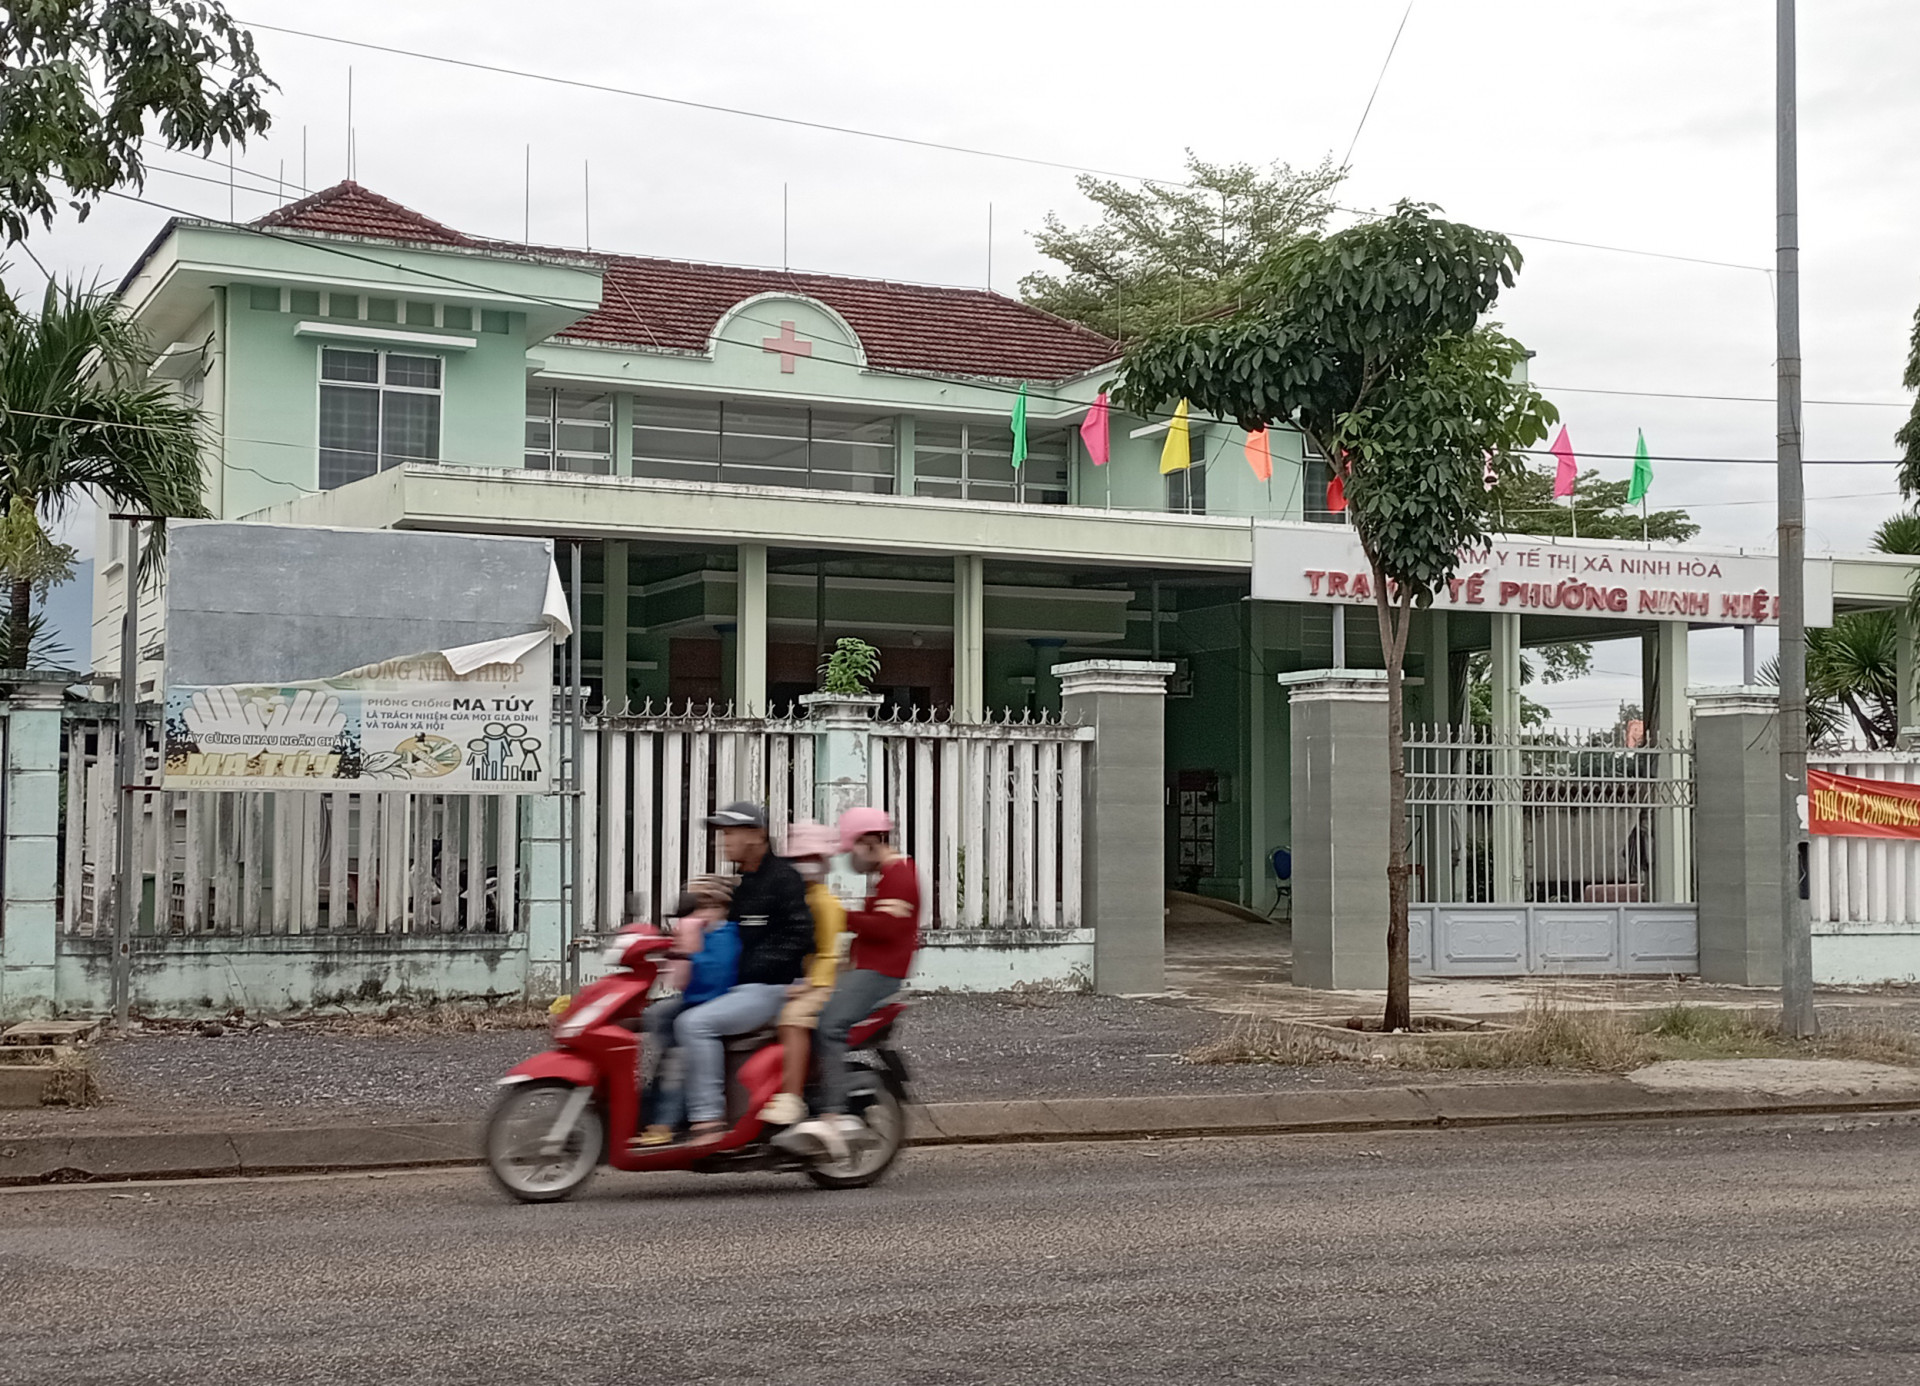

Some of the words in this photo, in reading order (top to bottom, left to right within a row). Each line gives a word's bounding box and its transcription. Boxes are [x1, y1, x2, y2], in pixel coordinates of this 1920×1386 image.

[1496, 551, 1509, 565] Y
[1517, 548, 1541, 568] TẾ
[1547, 554, 1577, 573] THỊ
[1582, 555, 1613, 573] XÃ
[1621, 558, 1670, 576] NINH
[1678, 557, 1722, 578] HÒA
[1304, 570, 1398, 603] TRẠ
[1448, 569, 1490, 604] TẾ
[1499, 577, 1628, 613] PHƯỜNG
[1638, 589, 1710, 616] NINH
[453, 698, 486, 711] MA
[491, 694, 534, 712] TÚY
[494, 714, 511, 722] GIA
[205, 732, 241, 745] CÙNG
[243, 734, 279, 746] NHAU
[280, 734, 316, 747] NGĂN
[186, 752, 248, 777] MA
